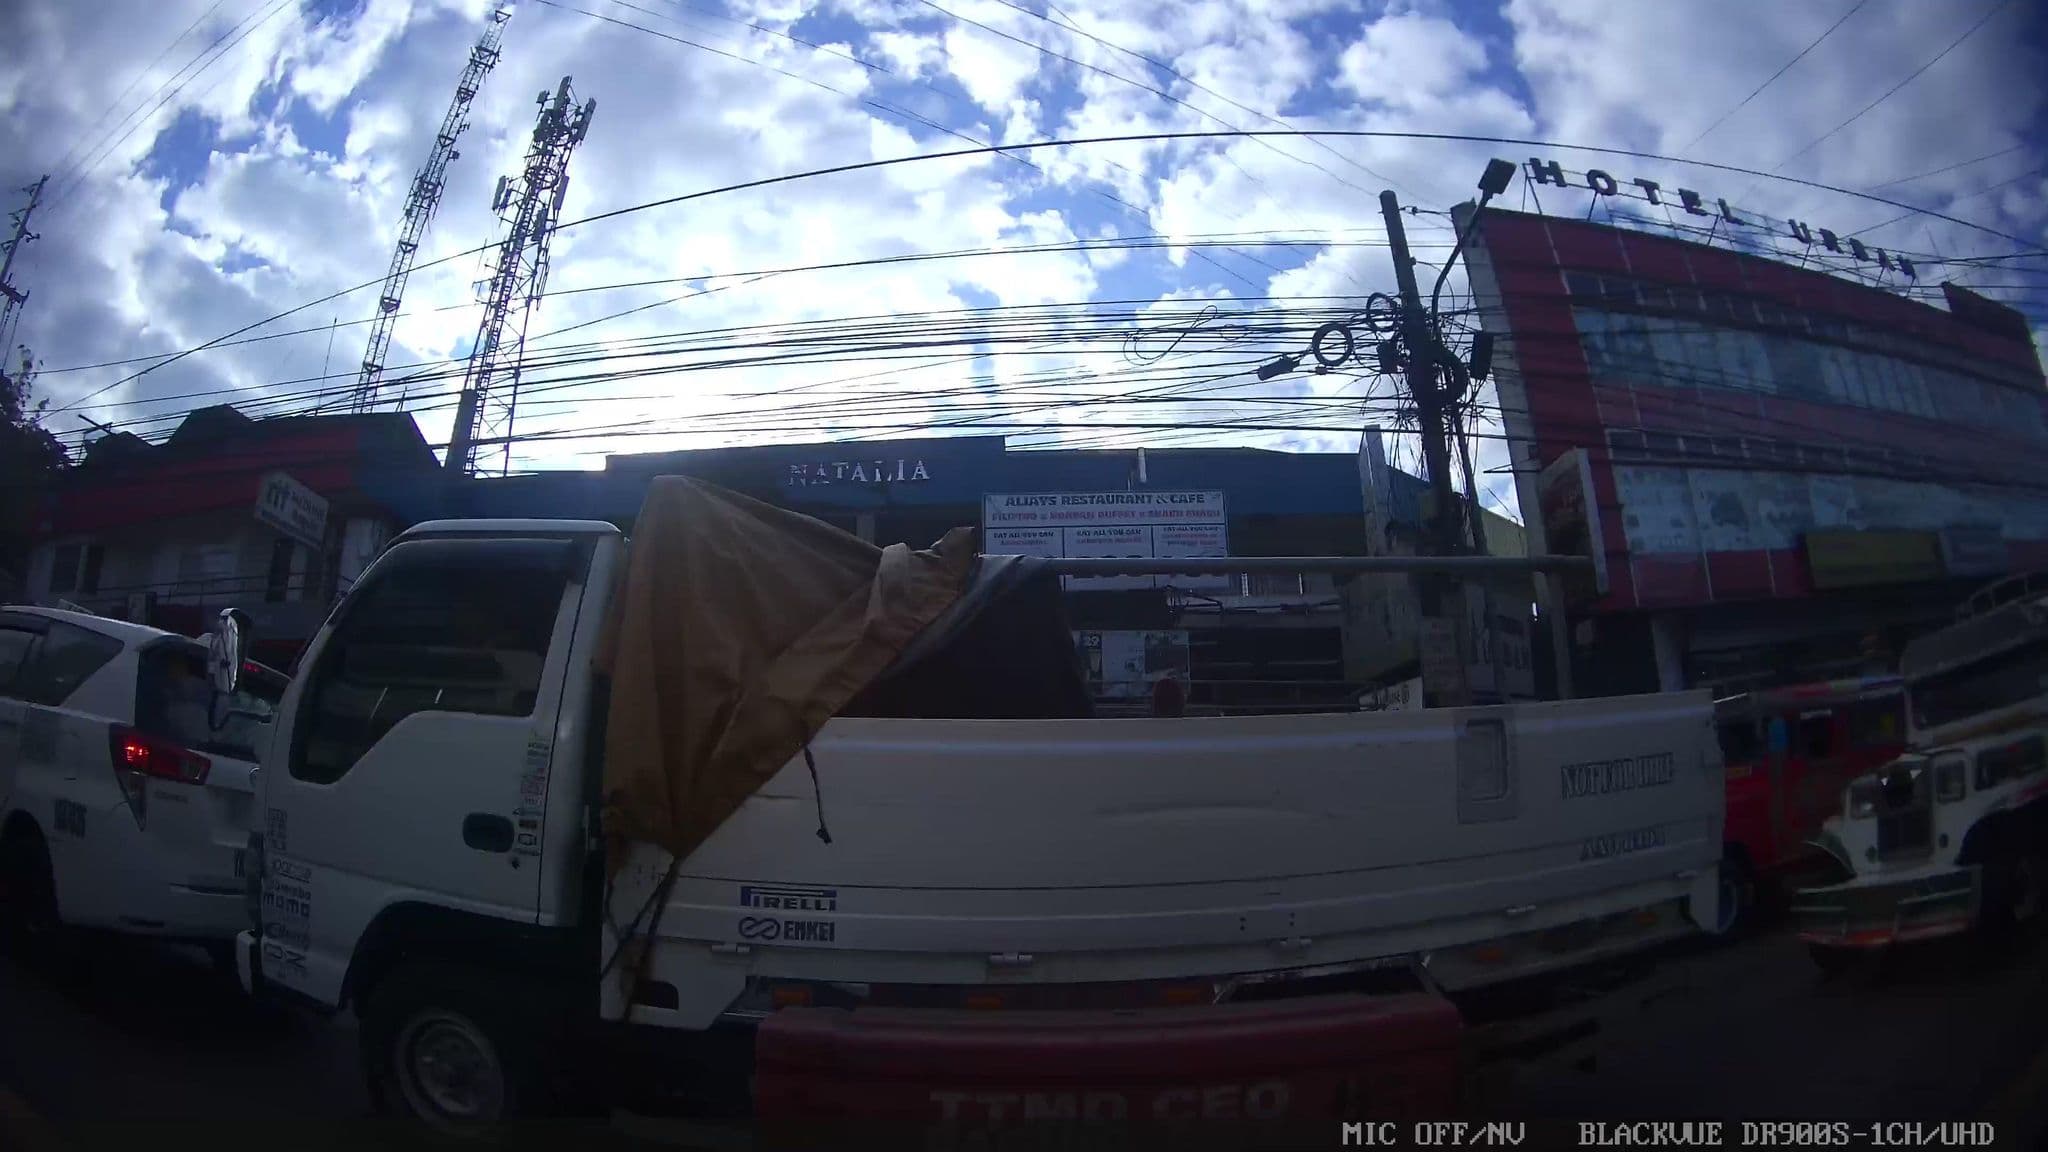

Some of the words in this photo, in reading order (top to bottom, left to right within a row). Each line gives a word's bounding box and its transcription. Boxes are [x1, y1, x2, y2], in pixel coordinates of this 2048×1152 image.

[1530, 158, 1745, 226] HOTEL
[788, 458, 932, 486] NATALIA
[1061, 493, 1152, 506] RESTAURANT
[1169, 493, 1205, 504] CAFE
[741, 886, 837, 911] PIRELLI
[784, 920, 835, 942] ENKEI
